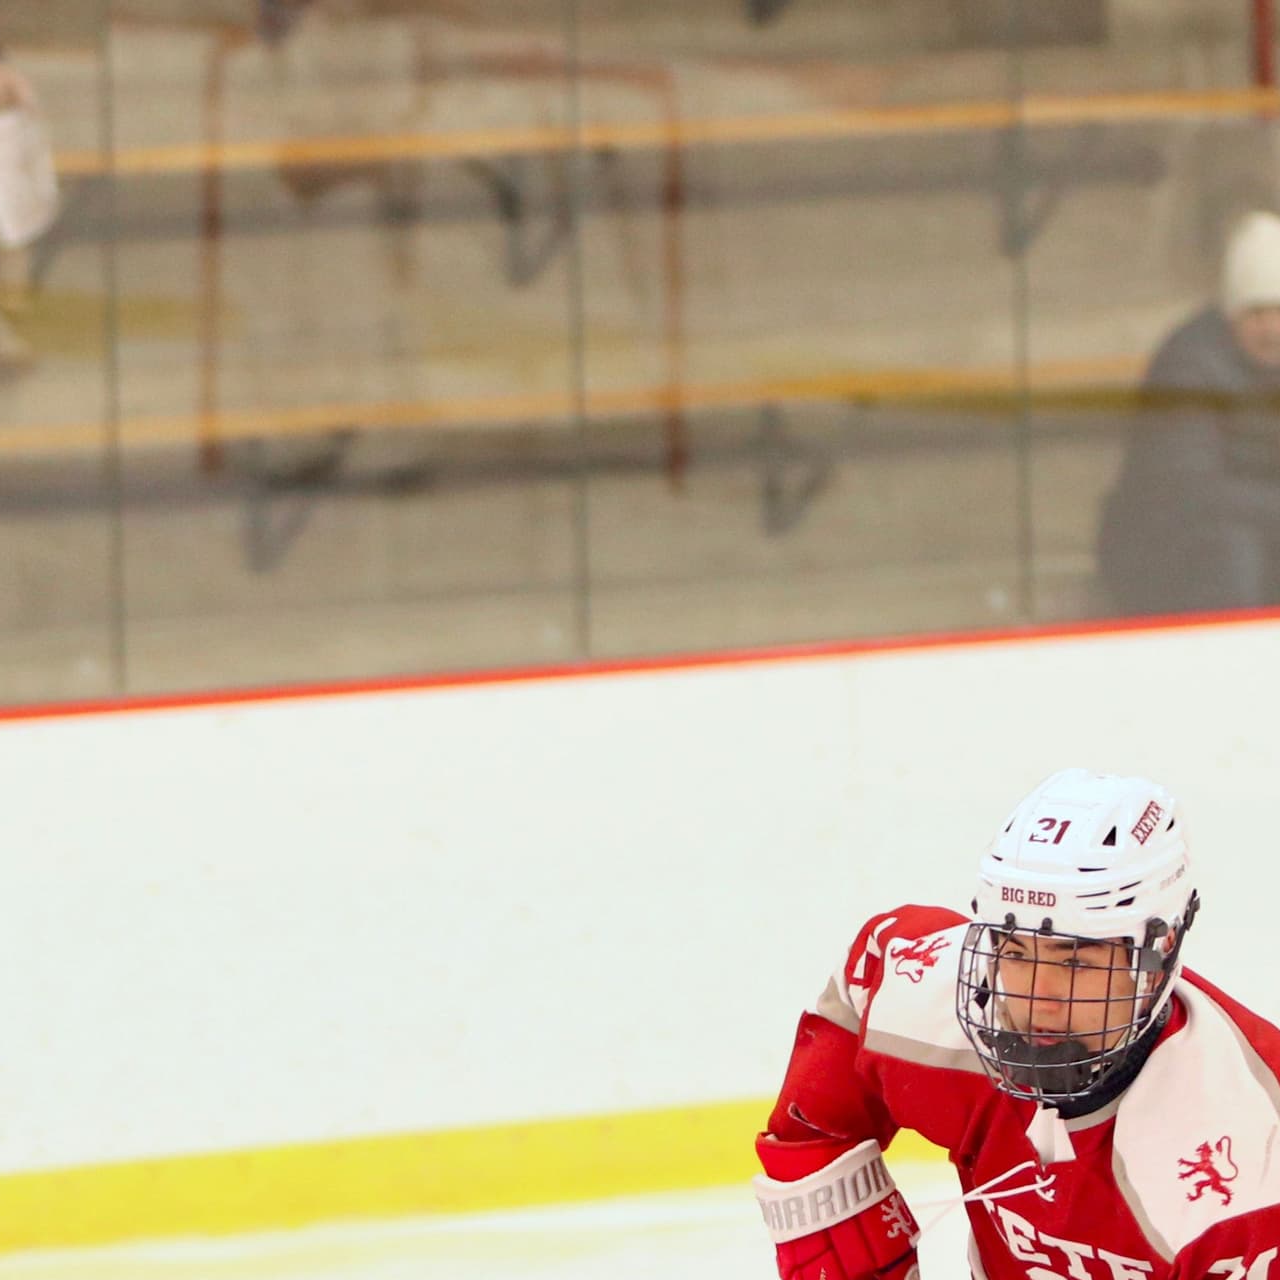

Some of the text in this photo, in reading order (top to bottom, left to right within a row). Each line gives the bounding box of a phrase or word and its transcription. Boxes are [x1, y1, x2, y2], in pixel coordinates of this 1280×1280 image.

[1028, 817, 1072, 845] 21
[1001, 886, 1057, 908] BIG RED
